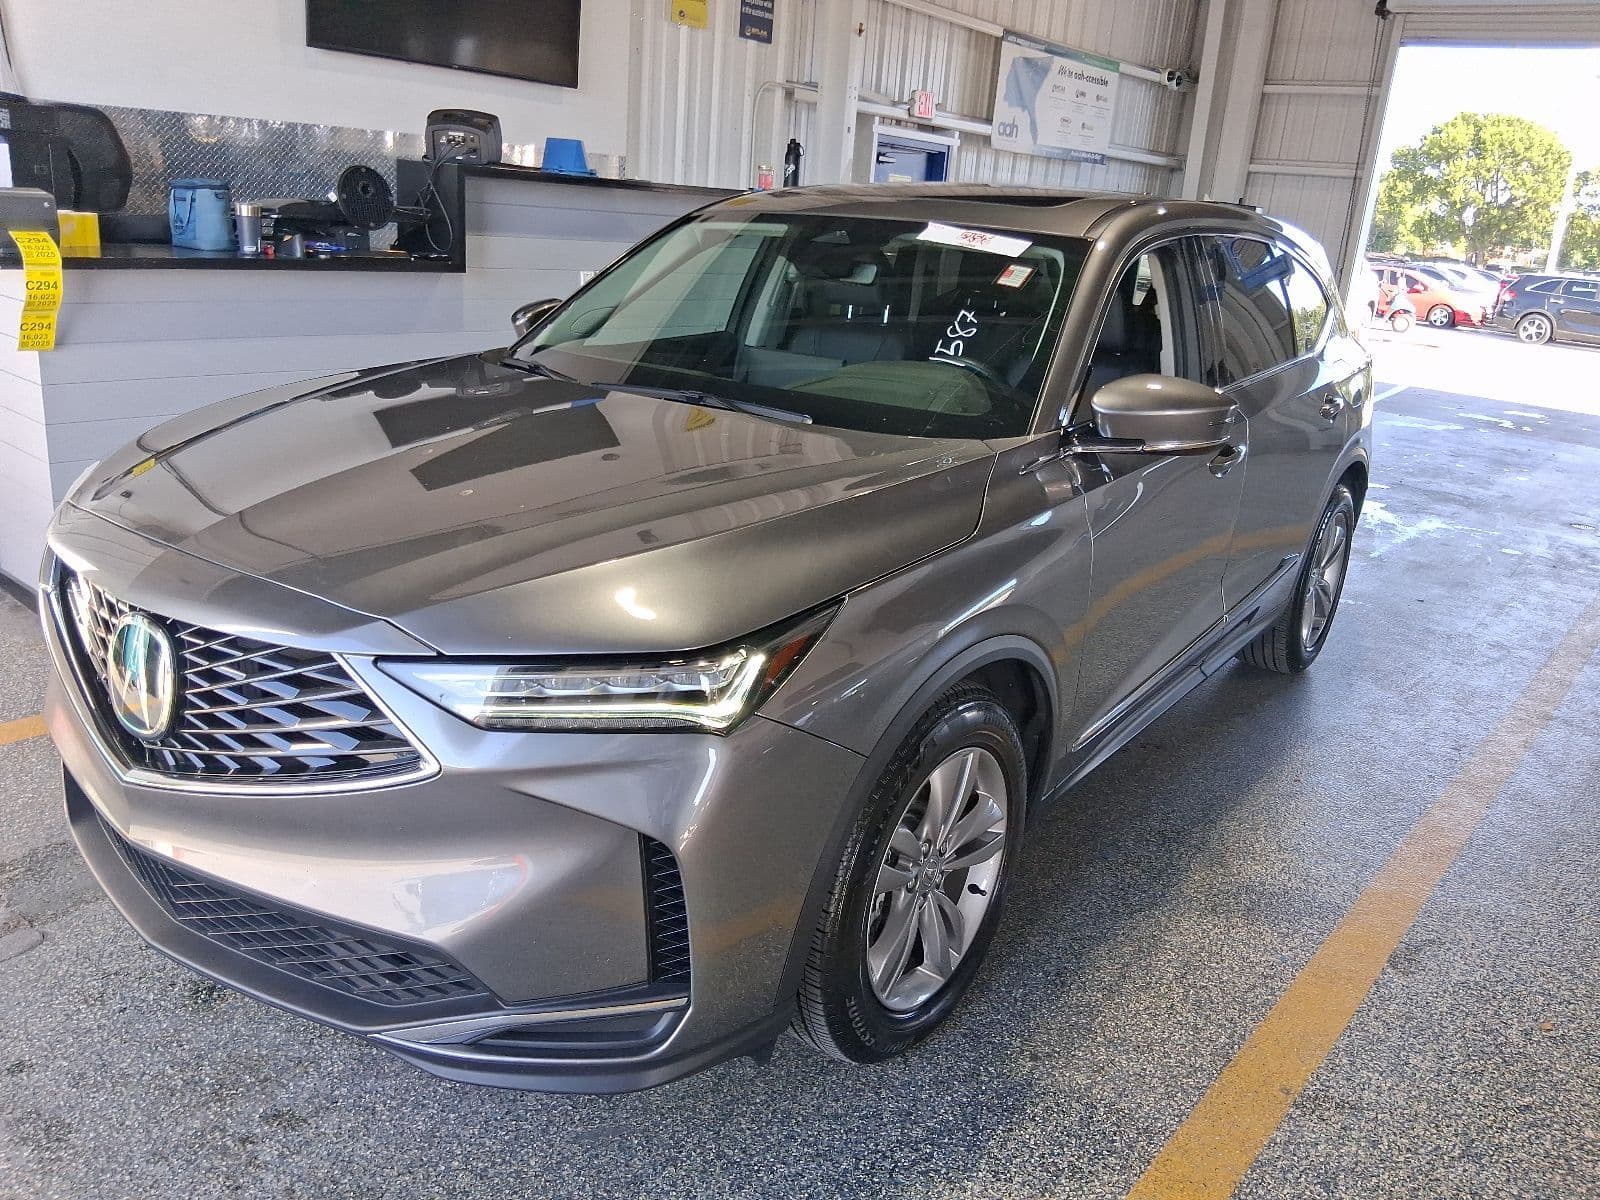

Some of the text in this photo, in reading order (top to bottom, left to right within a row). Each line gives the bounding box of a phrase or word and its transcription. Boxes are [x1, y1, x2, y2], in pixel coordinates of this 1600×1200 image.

[917, 91, 934, 117] EXIT
[25, 280, 59, 291] C294
[20, 322, 52, 332] C294
